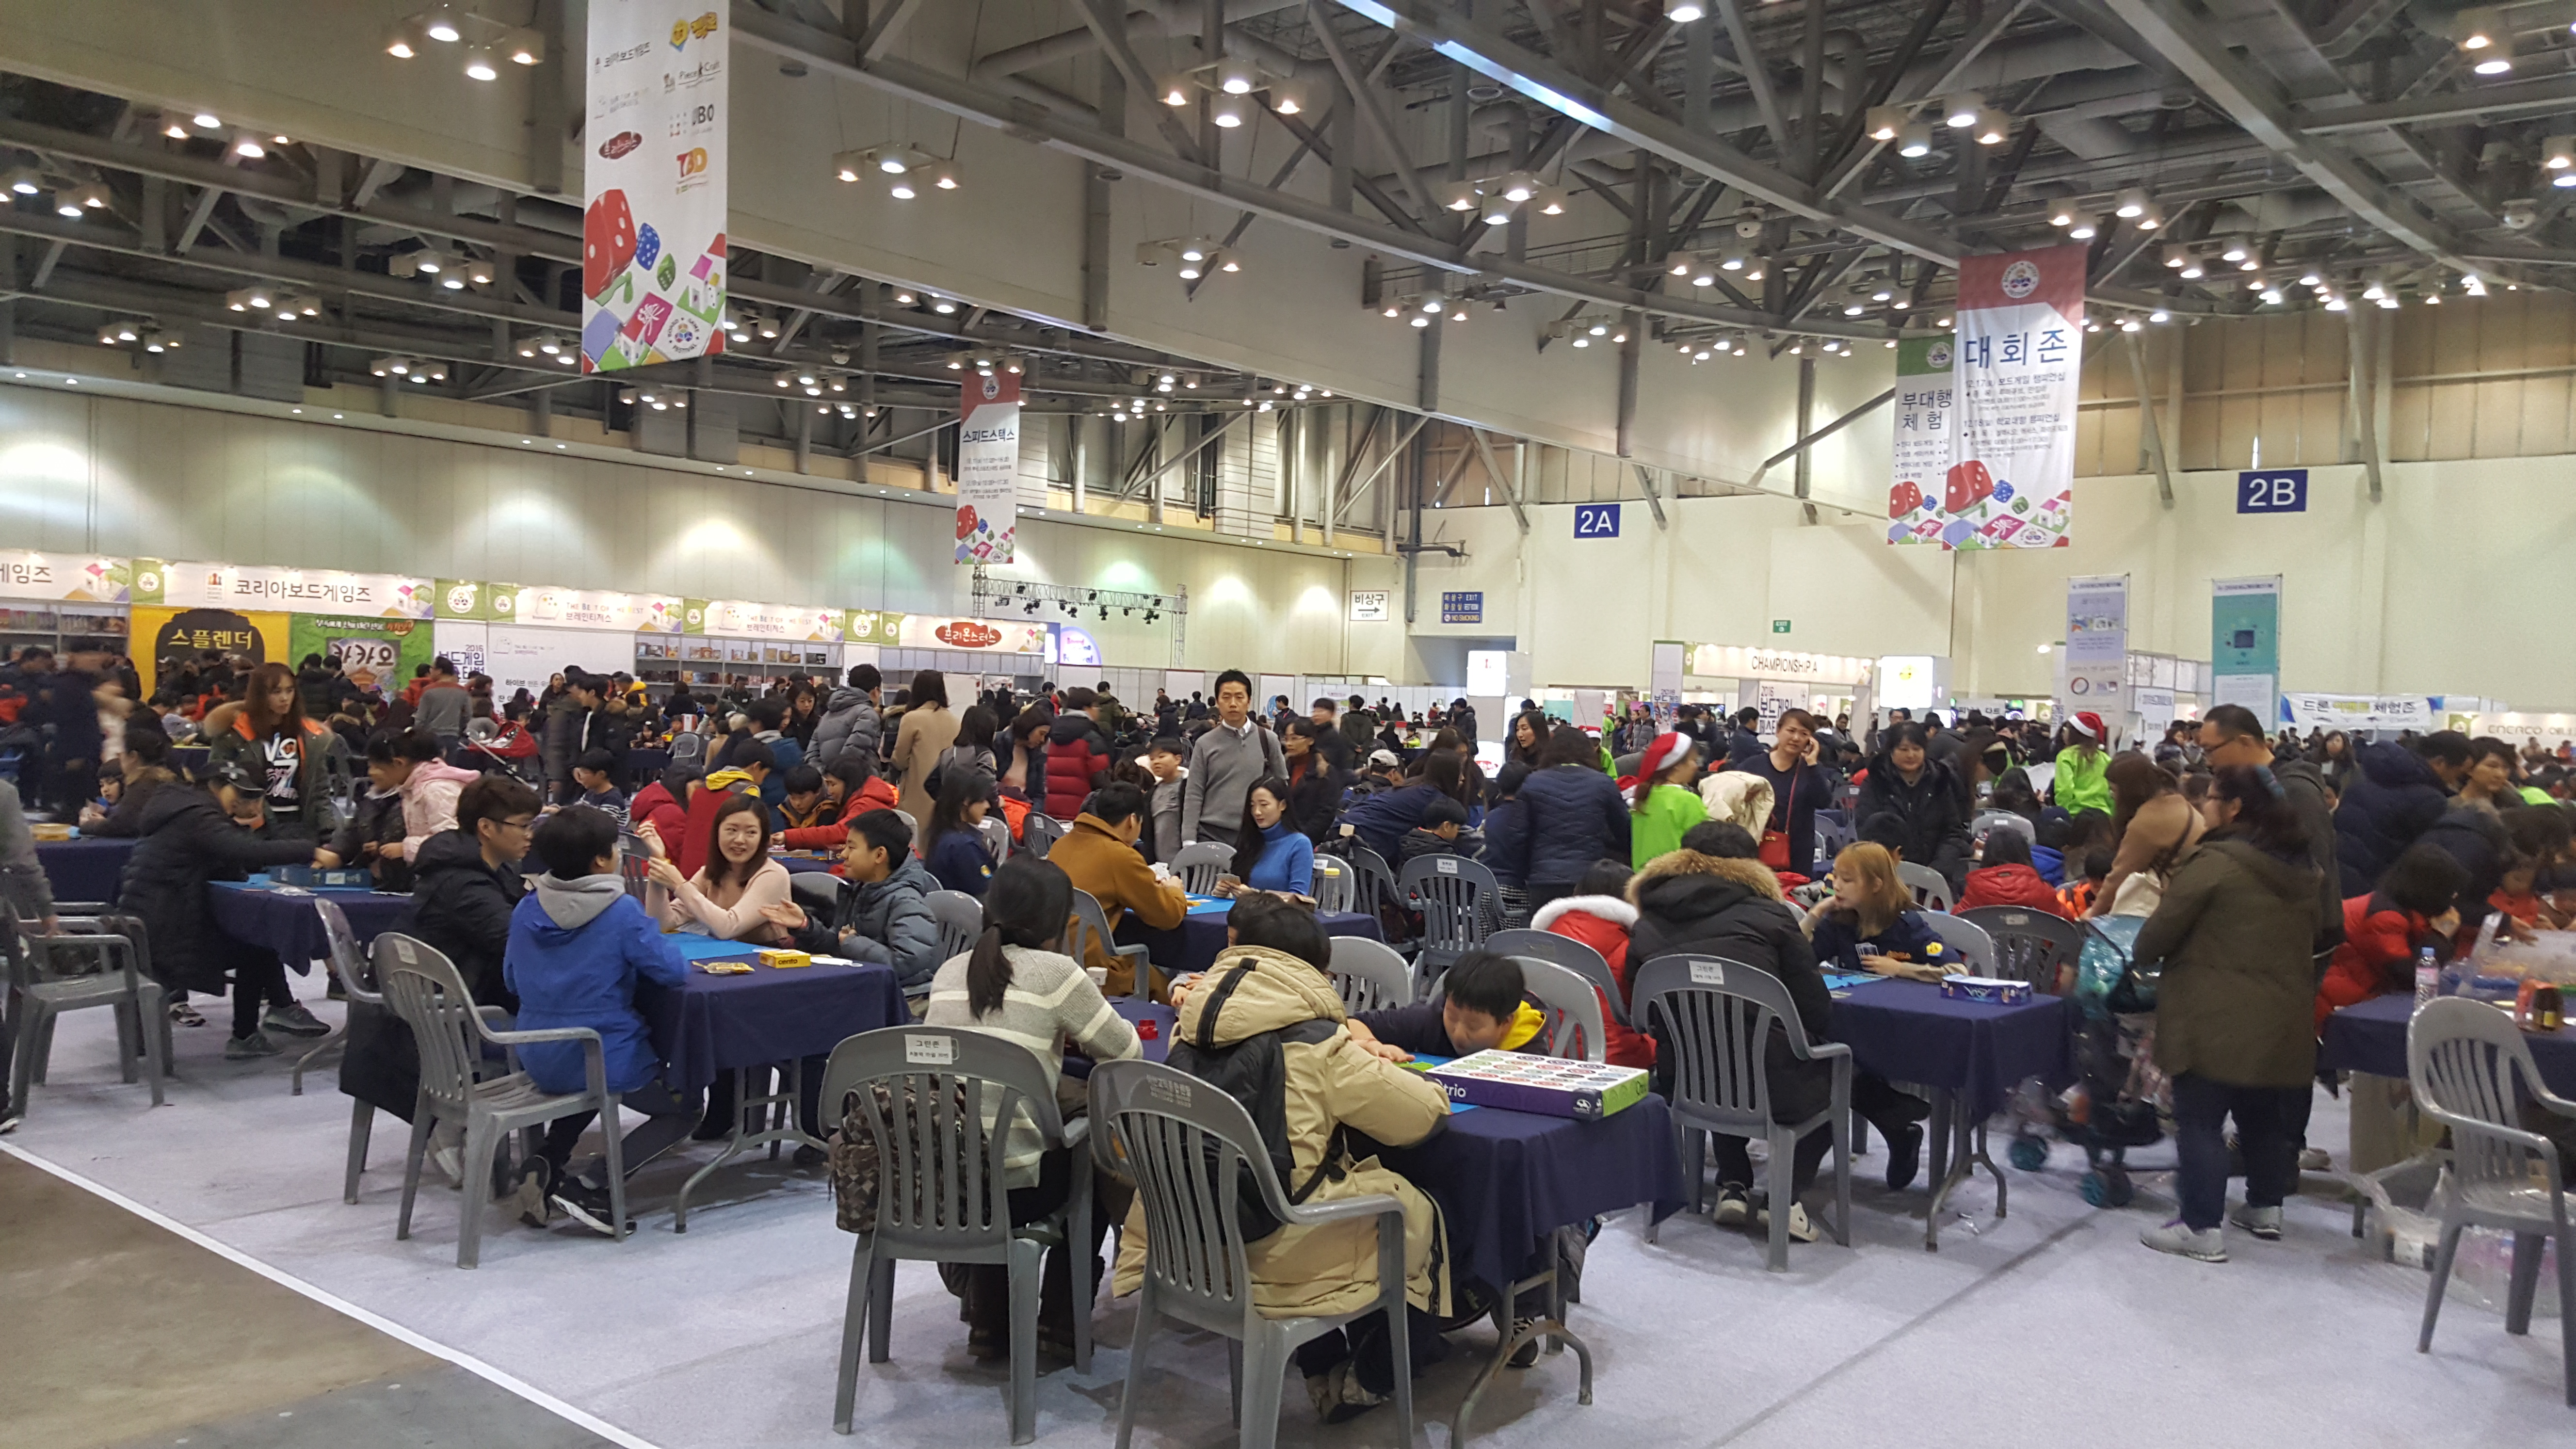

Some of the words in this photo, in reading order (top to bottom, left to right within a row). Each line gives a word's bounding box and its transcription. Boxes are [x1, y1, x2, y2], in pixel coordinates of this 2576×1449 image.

[1965, 329, 2067, 369] 대회존
[2248, 478, 2296, 506] 2B
[1580, 511, 1613, 533] 2A
[234, 579, 371, 603] 코리아보드게임즈
[1355, 594, 1385, 605] 비상구
[168, 628, 252, 651] 스플렌더
[466, 644, 484, 652] 2016
[332, 643, 394, 666] 카카오
[1752, 655, 1811, 673] CHAMPIONSHIP
[1812, 661, 1818, 673] A
[1761, 686, 1774, 697] 2016
[2303, 700, 2328, 712] 드론
